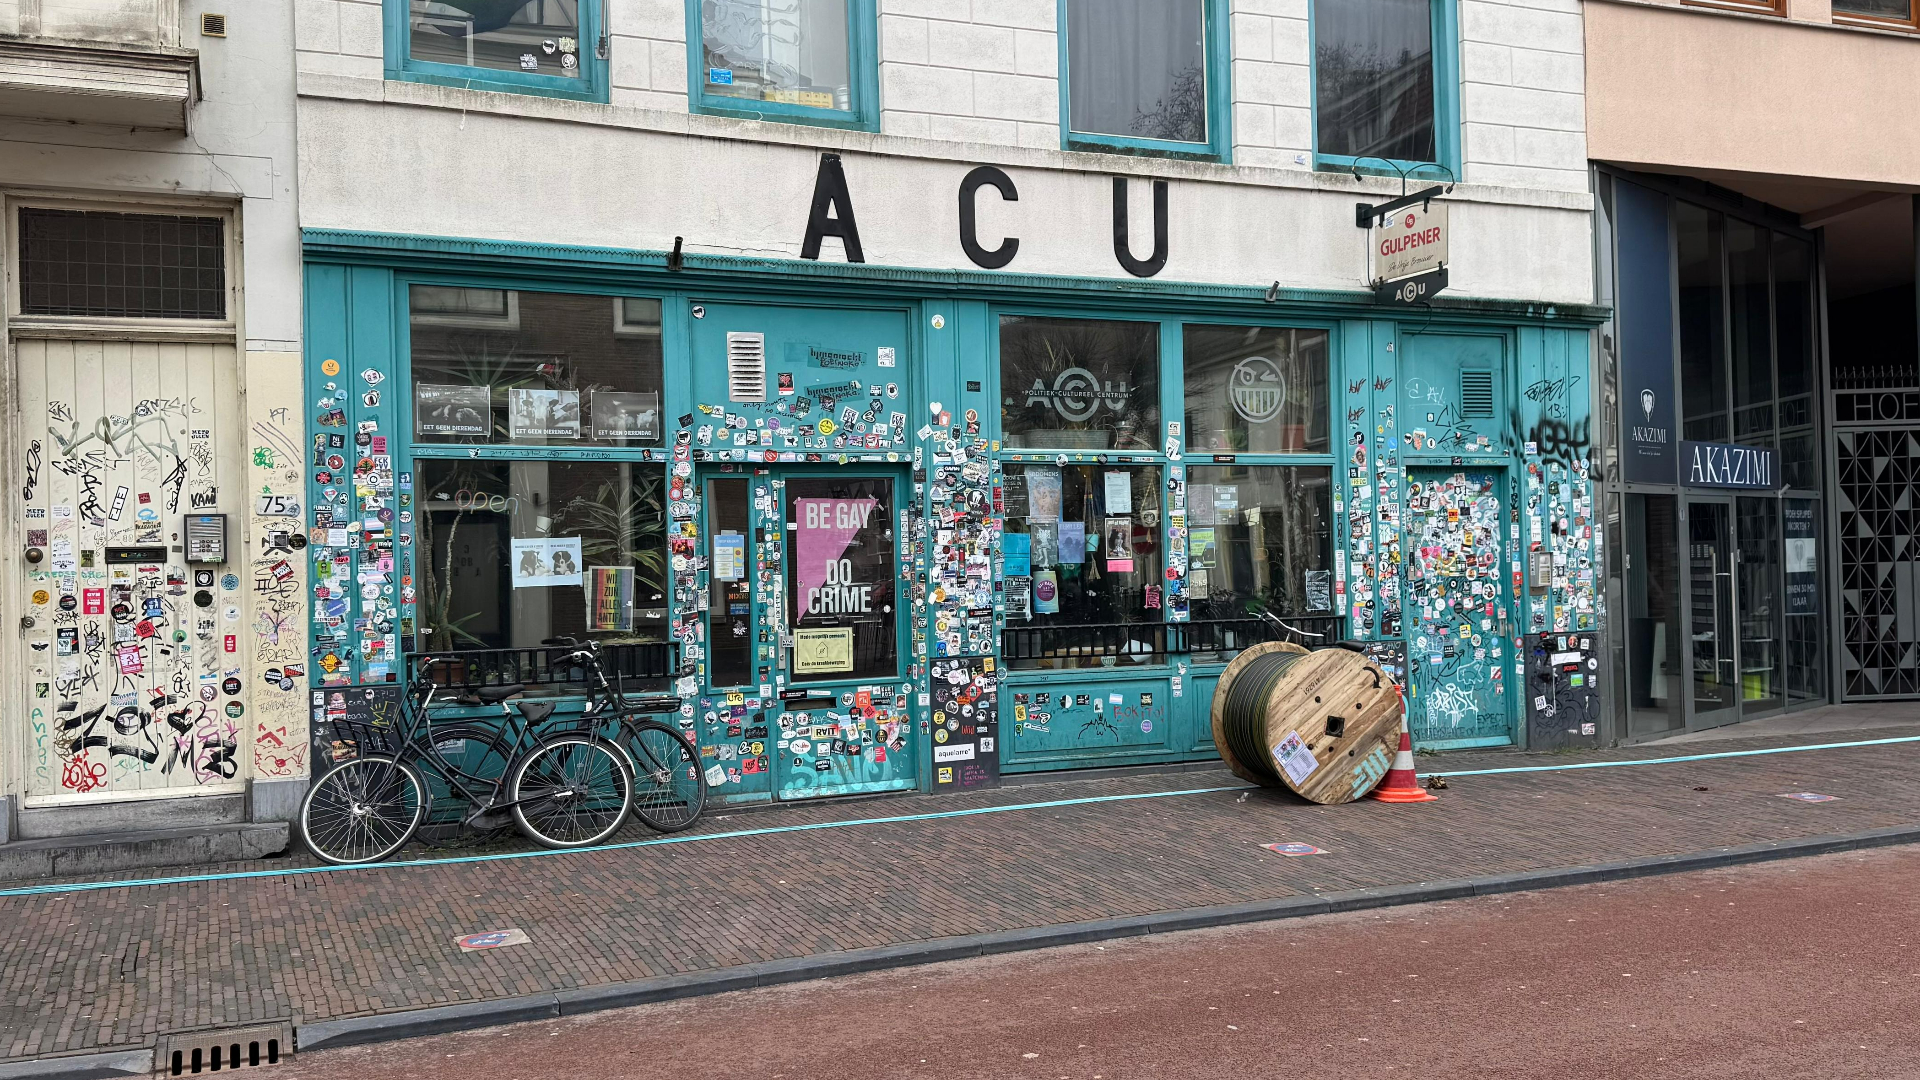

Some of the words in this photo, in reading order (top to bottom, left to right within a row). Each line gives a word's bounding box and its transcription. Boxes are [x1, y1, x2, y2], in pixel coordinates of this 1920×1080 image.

[1380, 226, 1441, 256] GULPENER
[1097, 391, 1129, 399] CENTRUM
[1631, 426, 1667, 443] AKAZIMI
[1689, 445, 1772, 486] AKAZIMI
[262, 496, 285, 513] 75
[806, 502, 831, 529] BE
[836, 502, 872, 529] GAY
[605, 573, 618, 584] WIJ
[826, 559, 852, 586] DO
[604, 586, 619, 597] ZIJN
[807, 586, 872, 615] CRIME
[597, 612, 624, 623] ANTIFA
